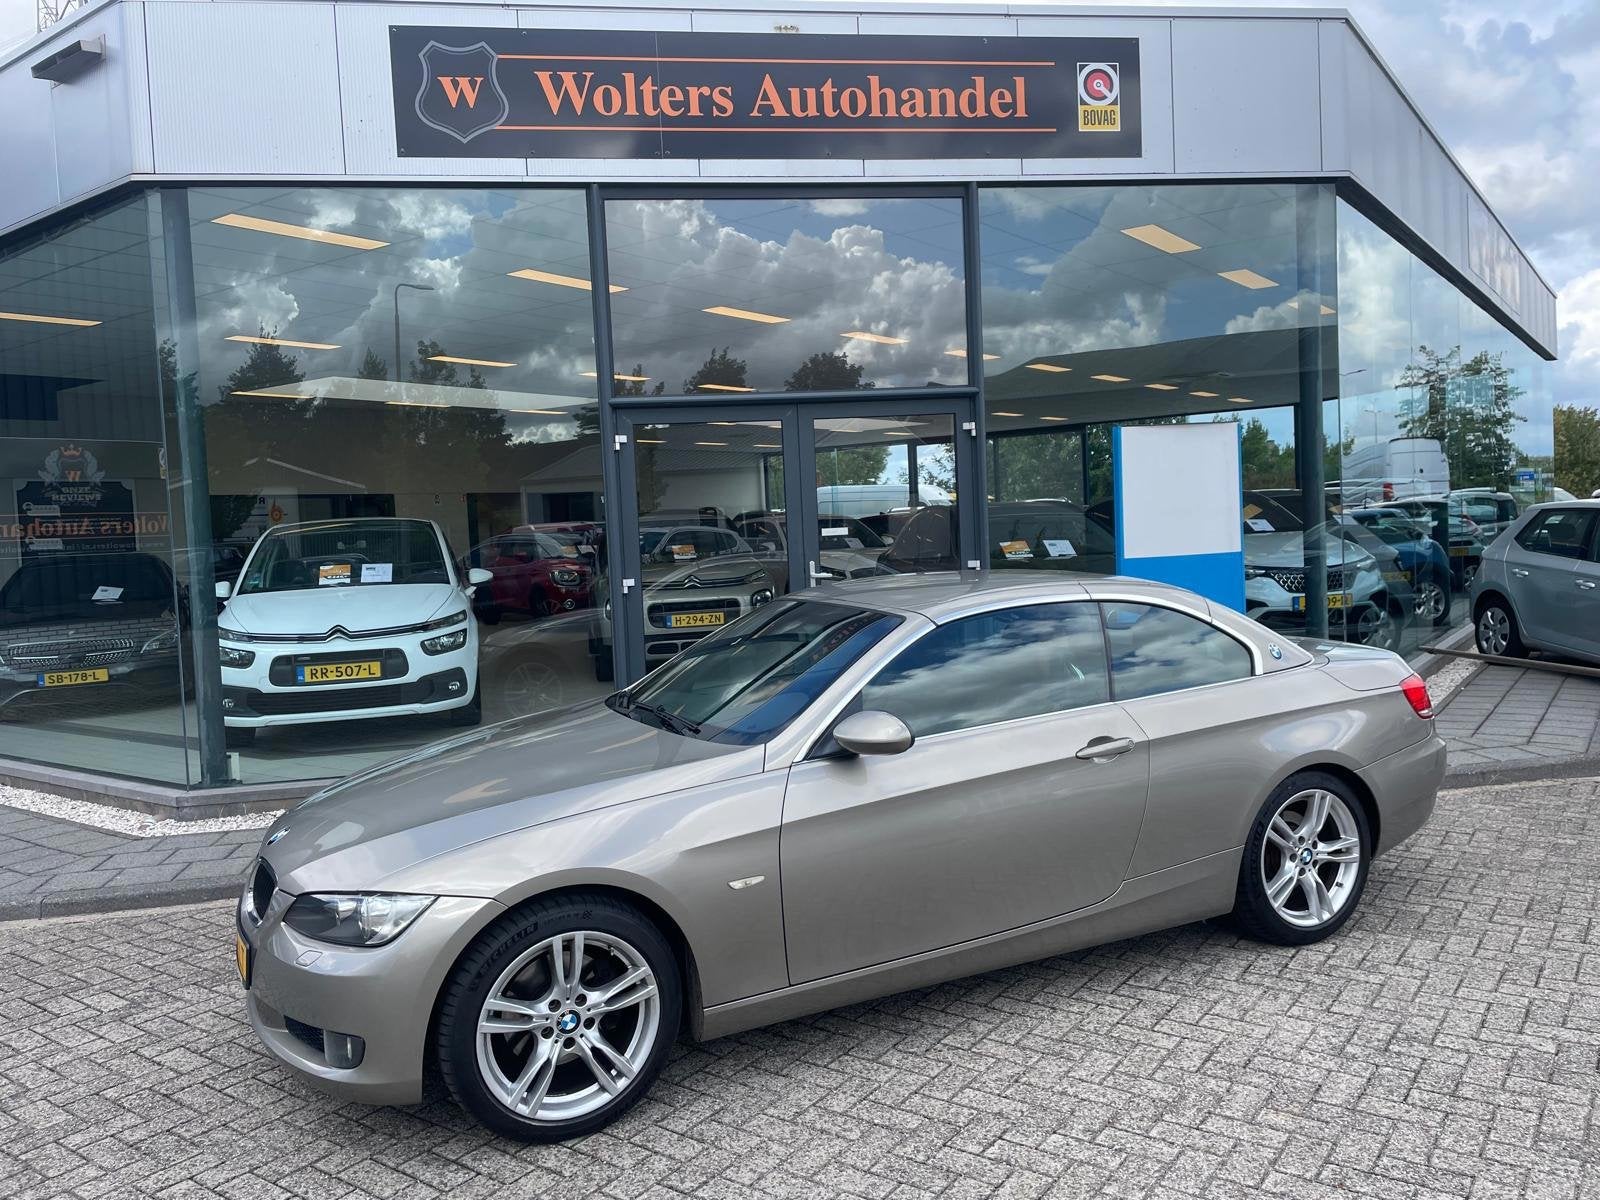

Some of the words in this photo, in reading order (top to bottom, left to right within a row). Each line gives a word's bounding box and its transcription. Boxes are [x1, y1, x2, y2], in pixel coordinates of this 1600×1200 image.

[437, 76, 484, 108] W
[534, 71, 734, 117] Wolters
[752, 74, 1028, 118] Autohandel
[1083, 109, 1116, 126] BOVAG
[675, 614, 721, 626] H-294-ZN
[47, 671, 99, 684] SB-178-L
[310, 664, 376, 680] RR-507-L
